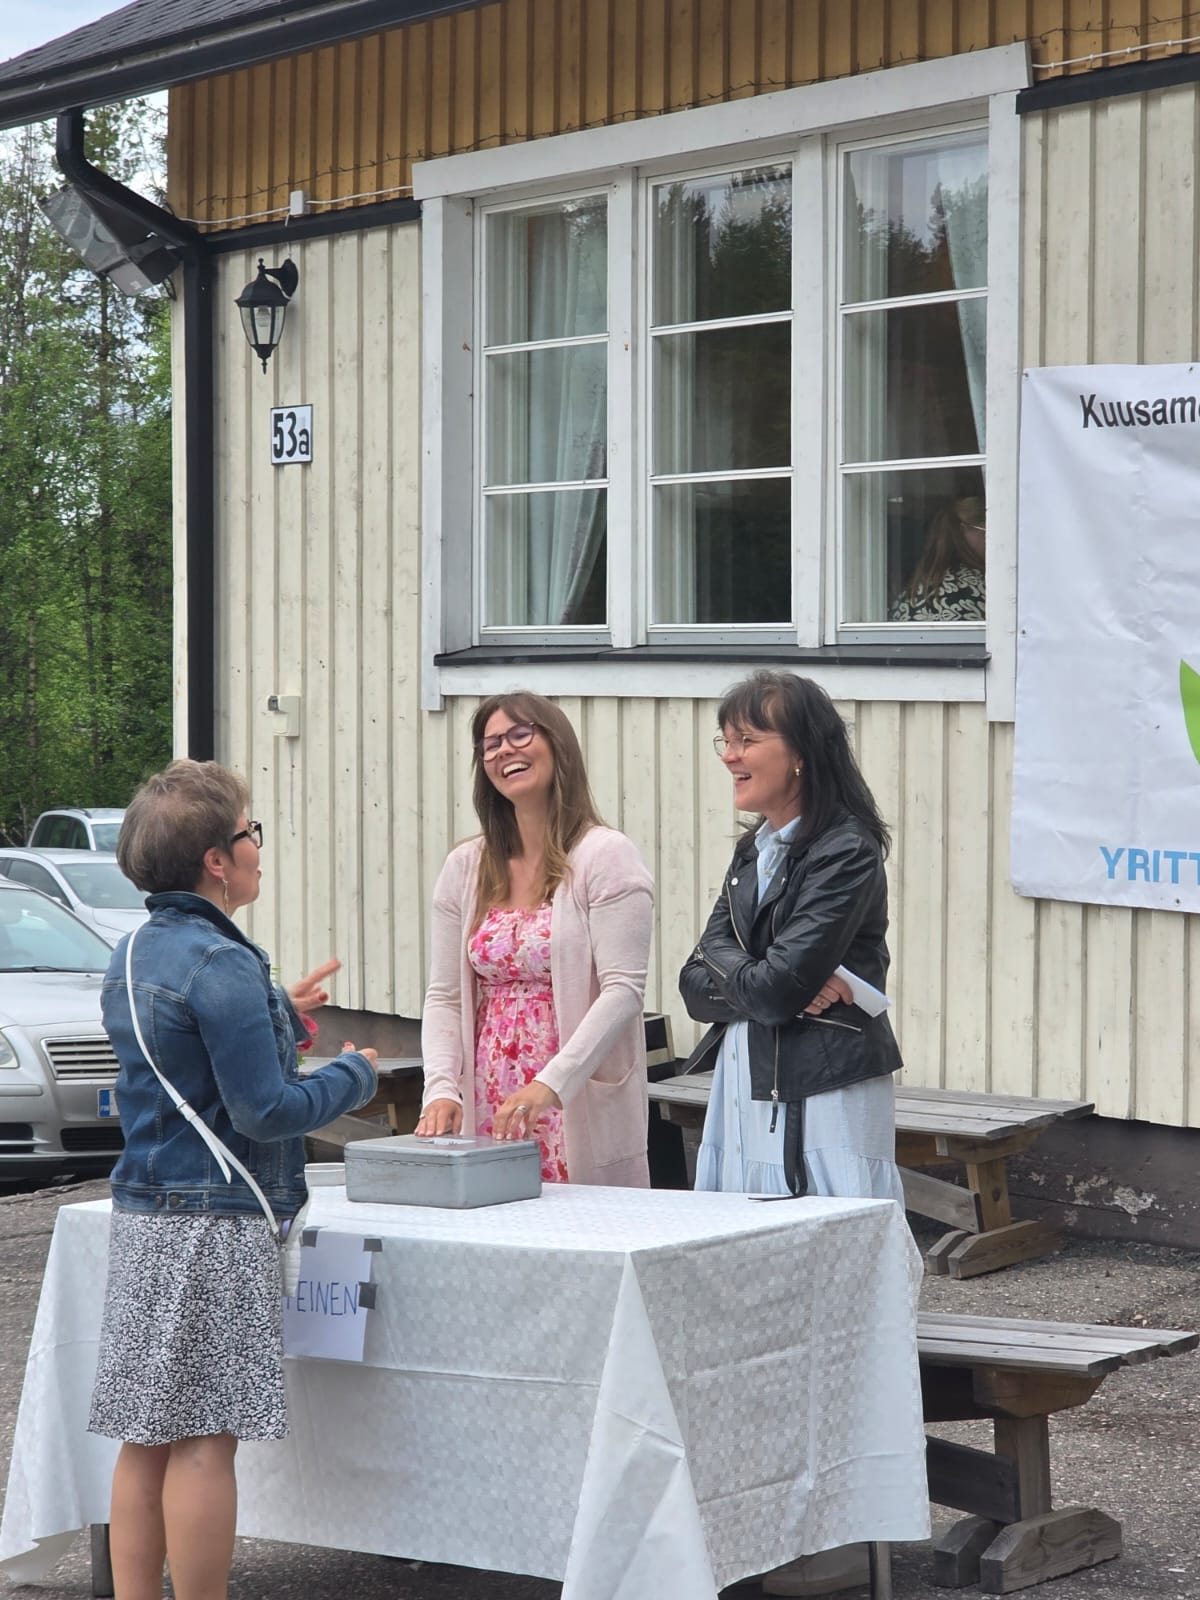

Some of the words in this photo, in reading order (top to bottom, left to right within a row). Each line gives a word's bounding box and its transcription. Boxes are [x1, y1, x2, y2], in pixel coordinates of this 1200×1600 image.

[1080, 394, 1200, 428] Kuusam
[273, 411, 310, 459] 53a
[281, 1280, 358, 1316] EINEN
